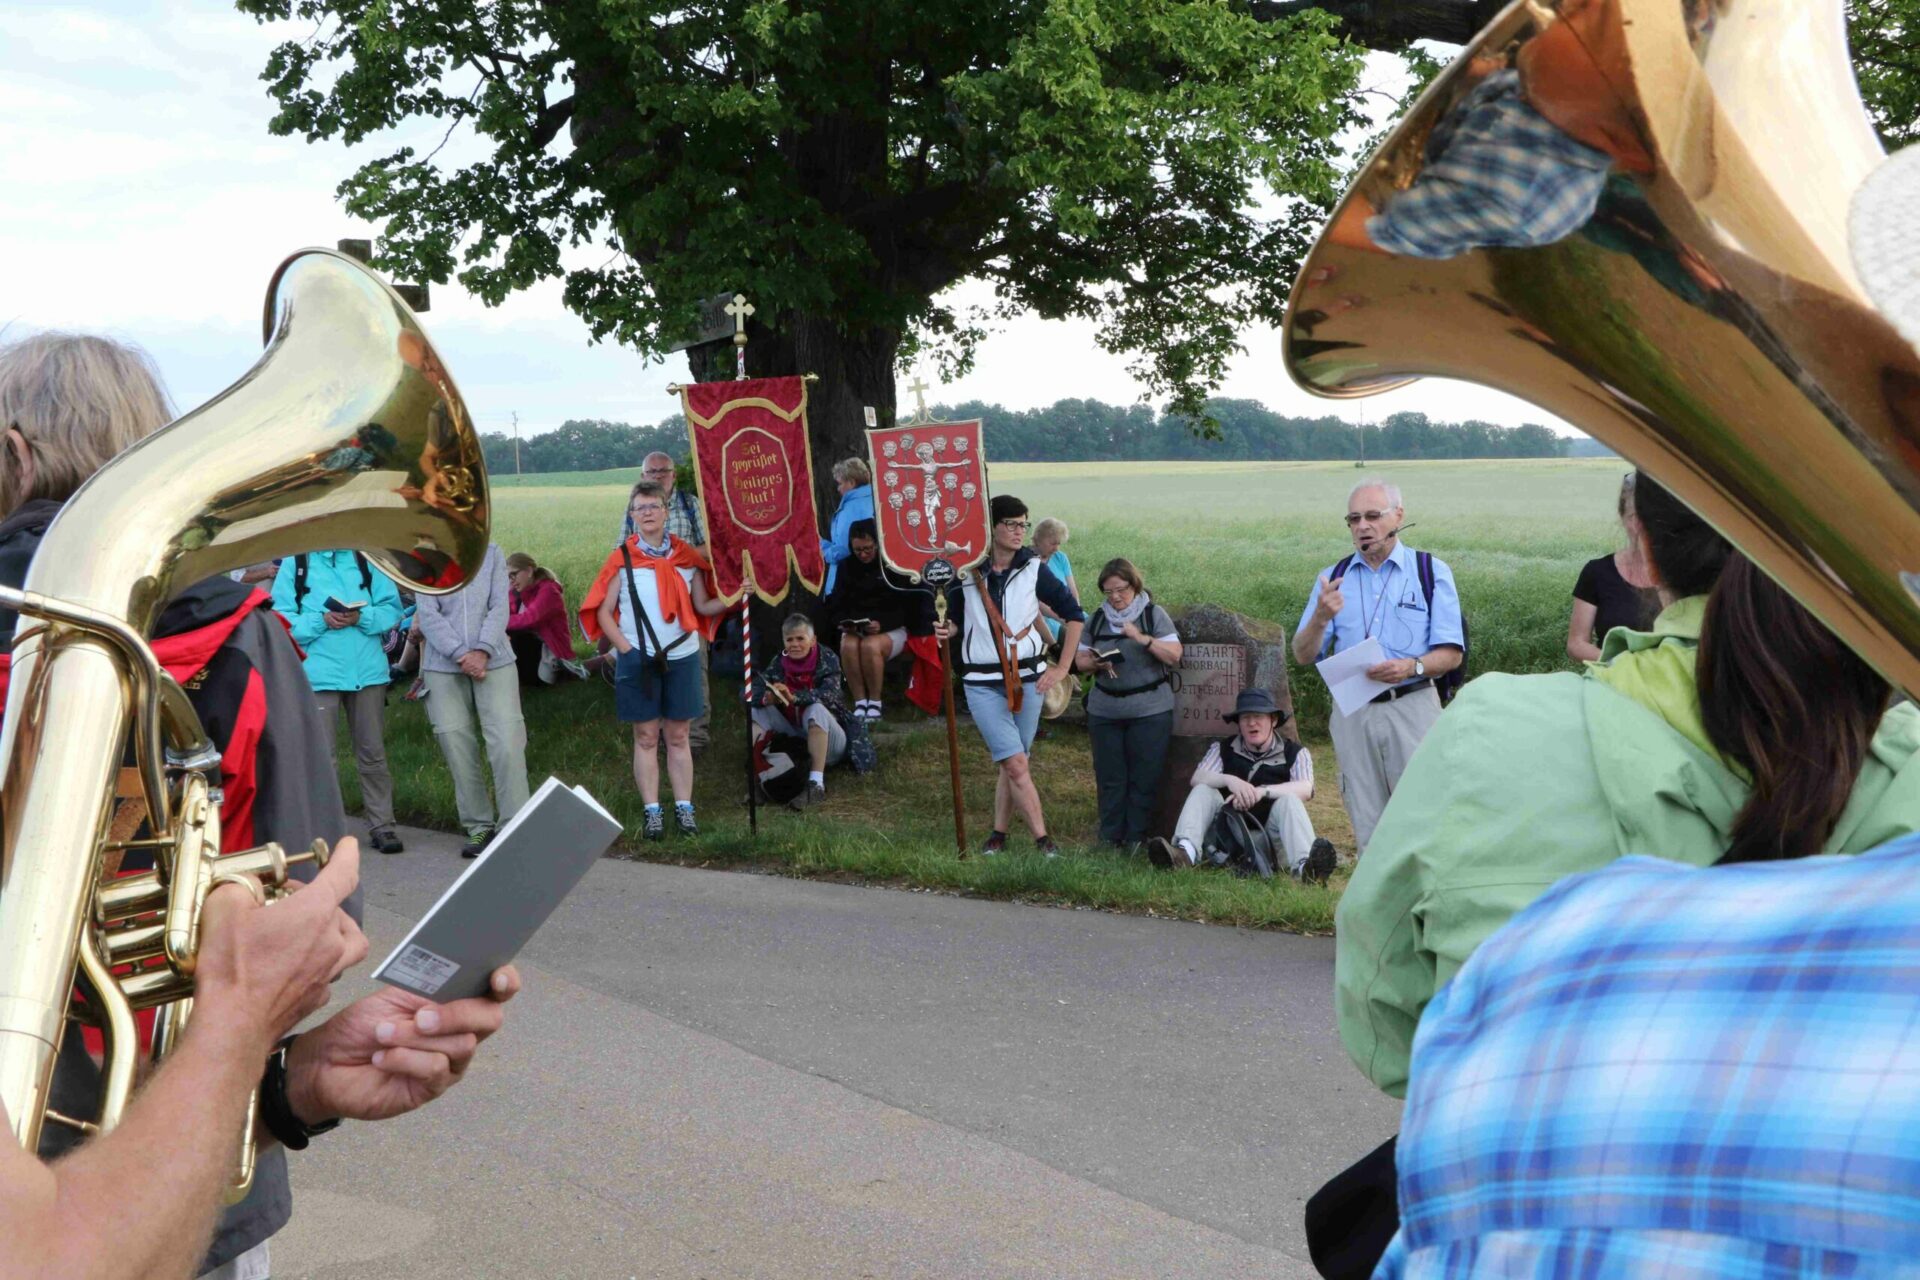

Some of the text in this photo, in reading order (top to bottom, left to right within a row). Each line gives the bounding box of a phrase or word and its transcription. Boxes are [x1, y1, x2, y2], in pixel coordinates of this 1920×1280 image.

[741, 441, 761, 455] Sei
[1184, 646, 1244, 658] LLFAHRTS
[1183, 707, 1222, 721] 2012
